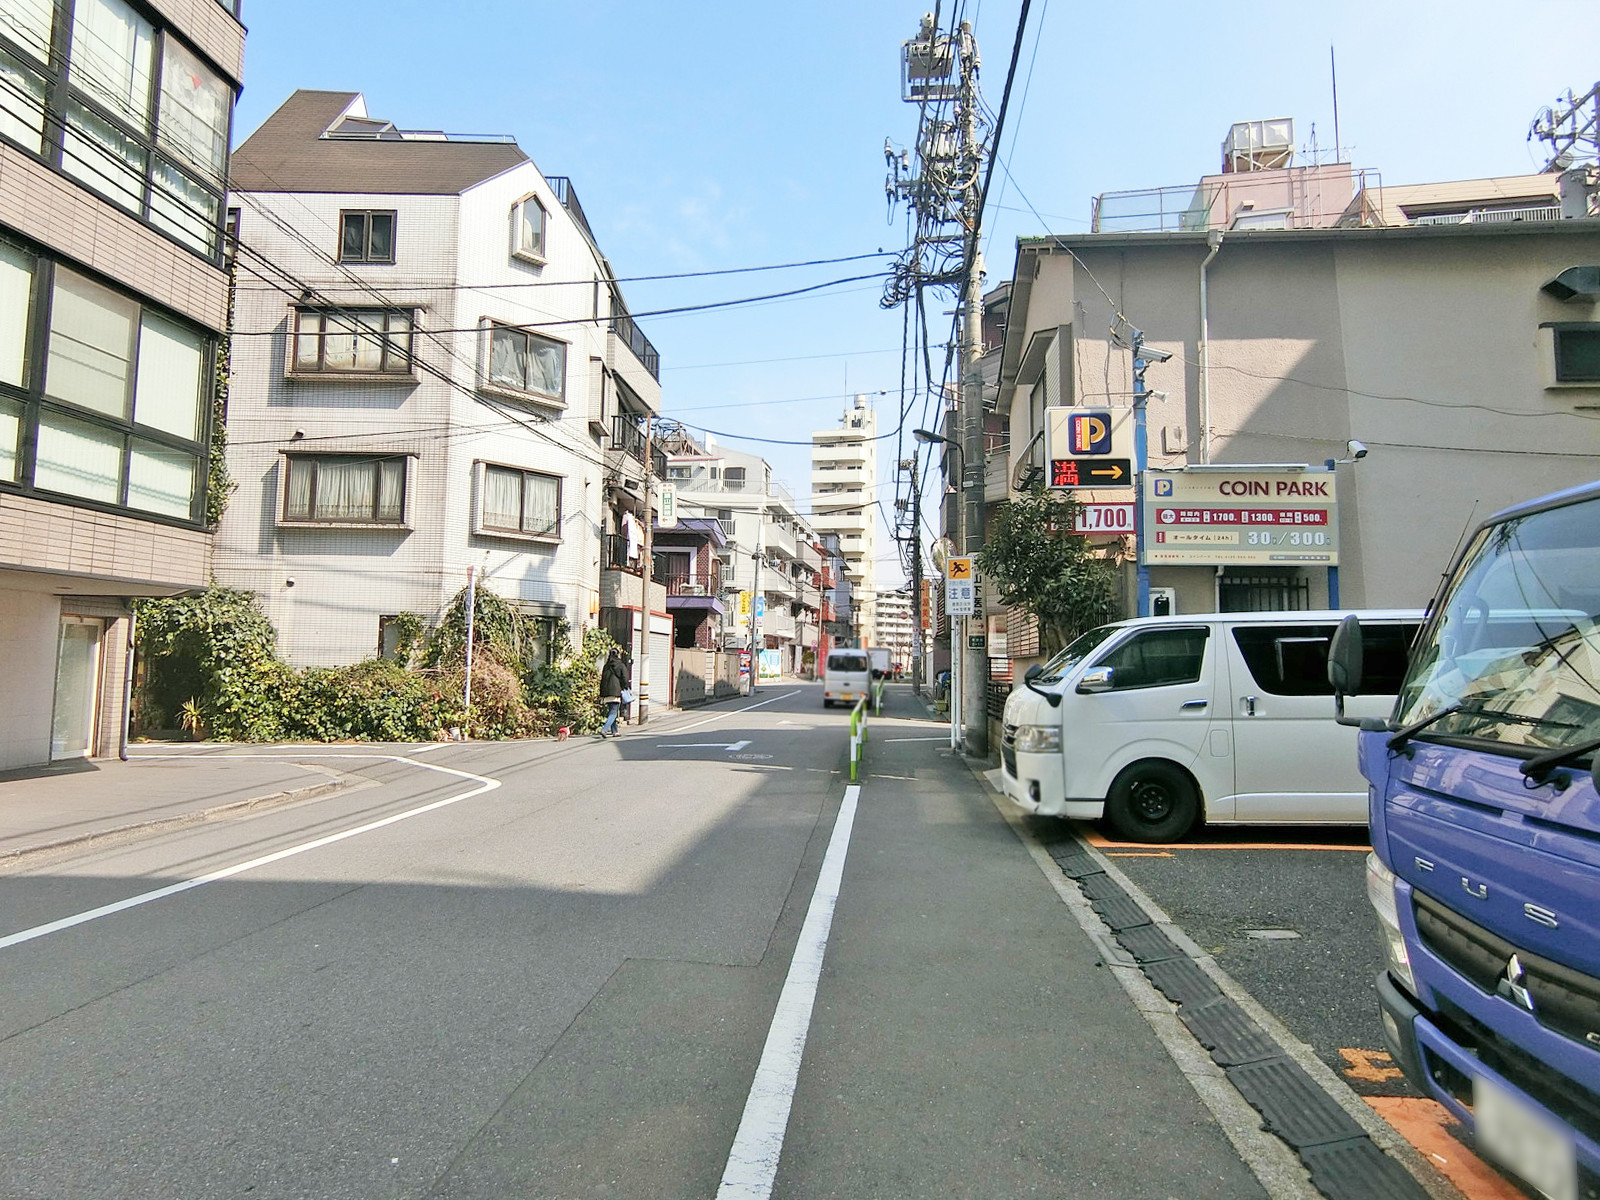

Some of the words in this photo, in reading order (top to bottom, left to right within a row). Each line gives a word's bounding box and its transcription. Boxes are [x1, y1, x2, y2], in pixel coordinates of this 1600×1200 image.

[1054, 461, 1080, 485] 満
[1219, 481, 1269, 496] COIN
[1276, 481, 1328, 496] PARK
[949, 587, 971, 600] 注意
